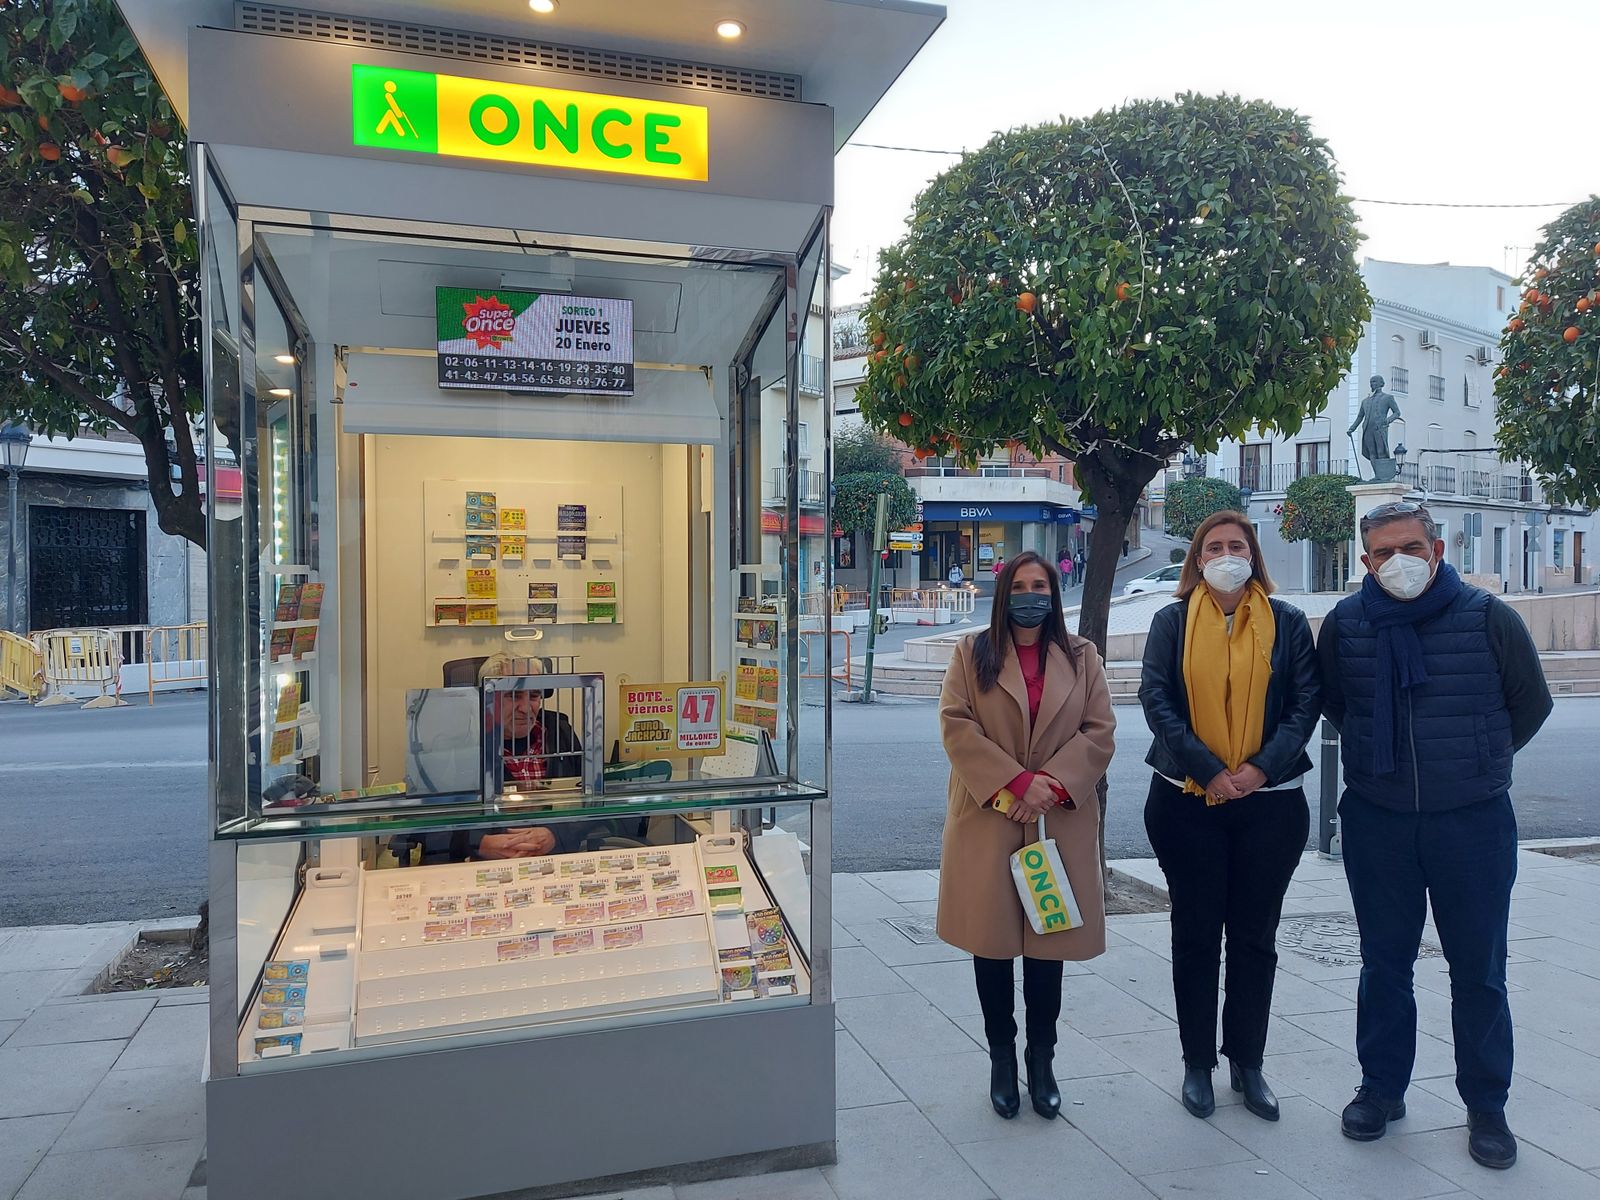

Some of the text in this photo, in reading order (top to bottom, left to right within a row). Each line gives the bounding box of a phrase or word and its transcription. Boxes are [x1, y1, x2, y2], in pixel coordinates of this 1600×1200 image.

[469, 94, 682, 165] ONCE
[562, 306, 603, 317] SORTEO 1
[556, 319, 610, 335] JUEVES
[556, 337, 611, 351] 20 Enero
[960, 507, 992, 518] BBVA
[627, 691, 663, 704] BOTE
[627, 704, 674, 715] viernes
[682, 695, 715, 723] 47
[634, 720, 661, 732] EURO
[625, 729, 670, 743] JACKPOT
[679, 732, 718, 741] MILLONES
[1025, 850, 1066, 929] ONCE
